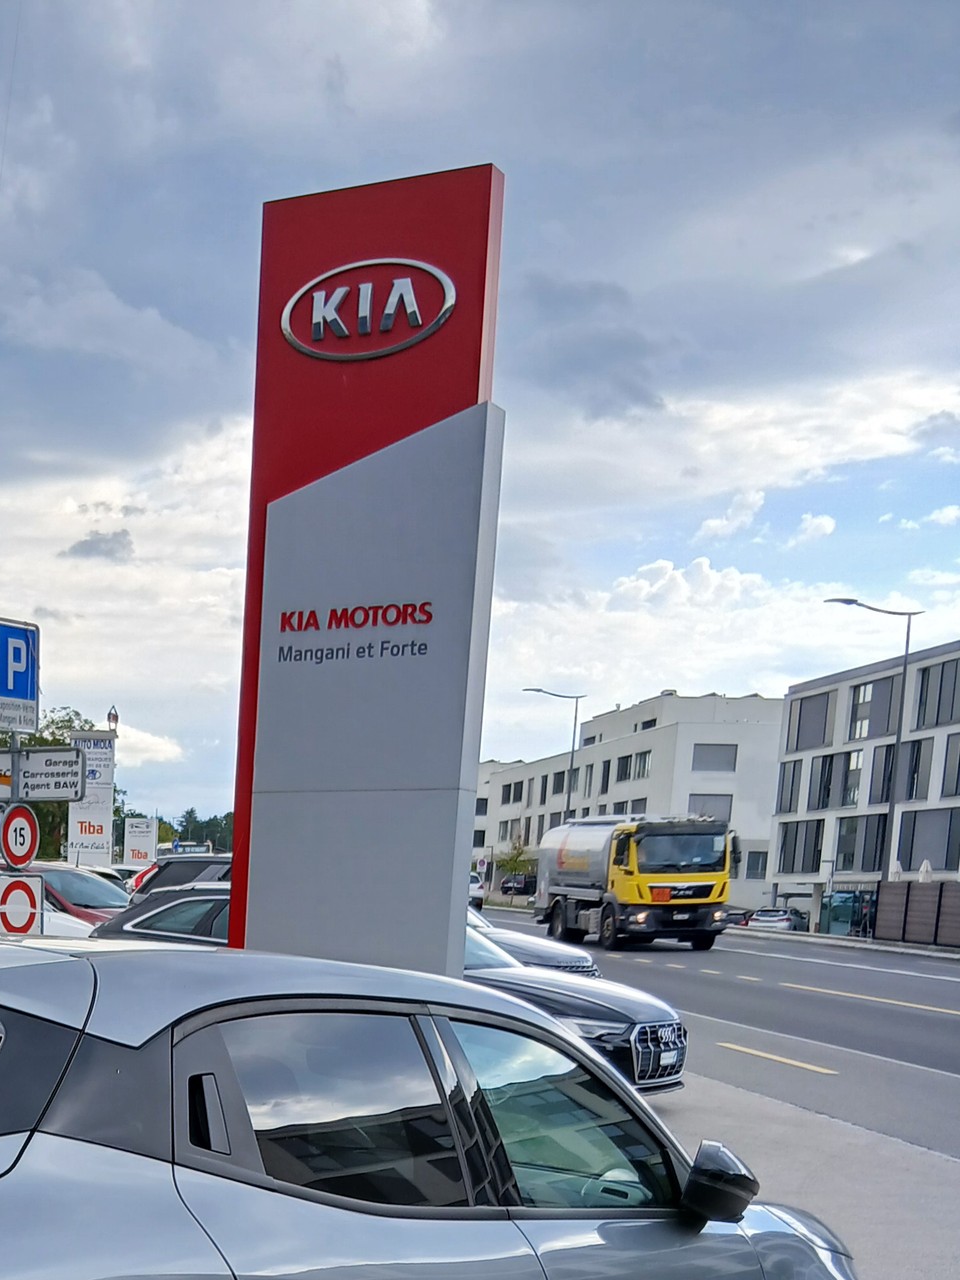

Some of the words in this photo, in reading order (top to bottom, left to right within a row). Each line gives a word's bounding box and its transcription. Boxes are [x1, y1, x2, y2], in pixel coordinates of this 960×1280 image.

[311, 277, 423, 342] KIA
[279, 610, 320, 633] KIA
[327, 601, 433, 629] MOTORS
[278, 643, 351, 665] Mangani
[355, 642, 374, 659] et
[379, 640, 428, 658] Forte
[7, 638, 27, 690] P
[44, 758, 79, 768] Garage
[22, 770, 79, 779] Carrosserie
[22, 781, 51, 791] Agent
[53, 780, 79, 790] BAW
[13, 826, 26, 847] 15
[77, 821, 104, 835] Tiba
[130, 848, 148, 860] Tiba
